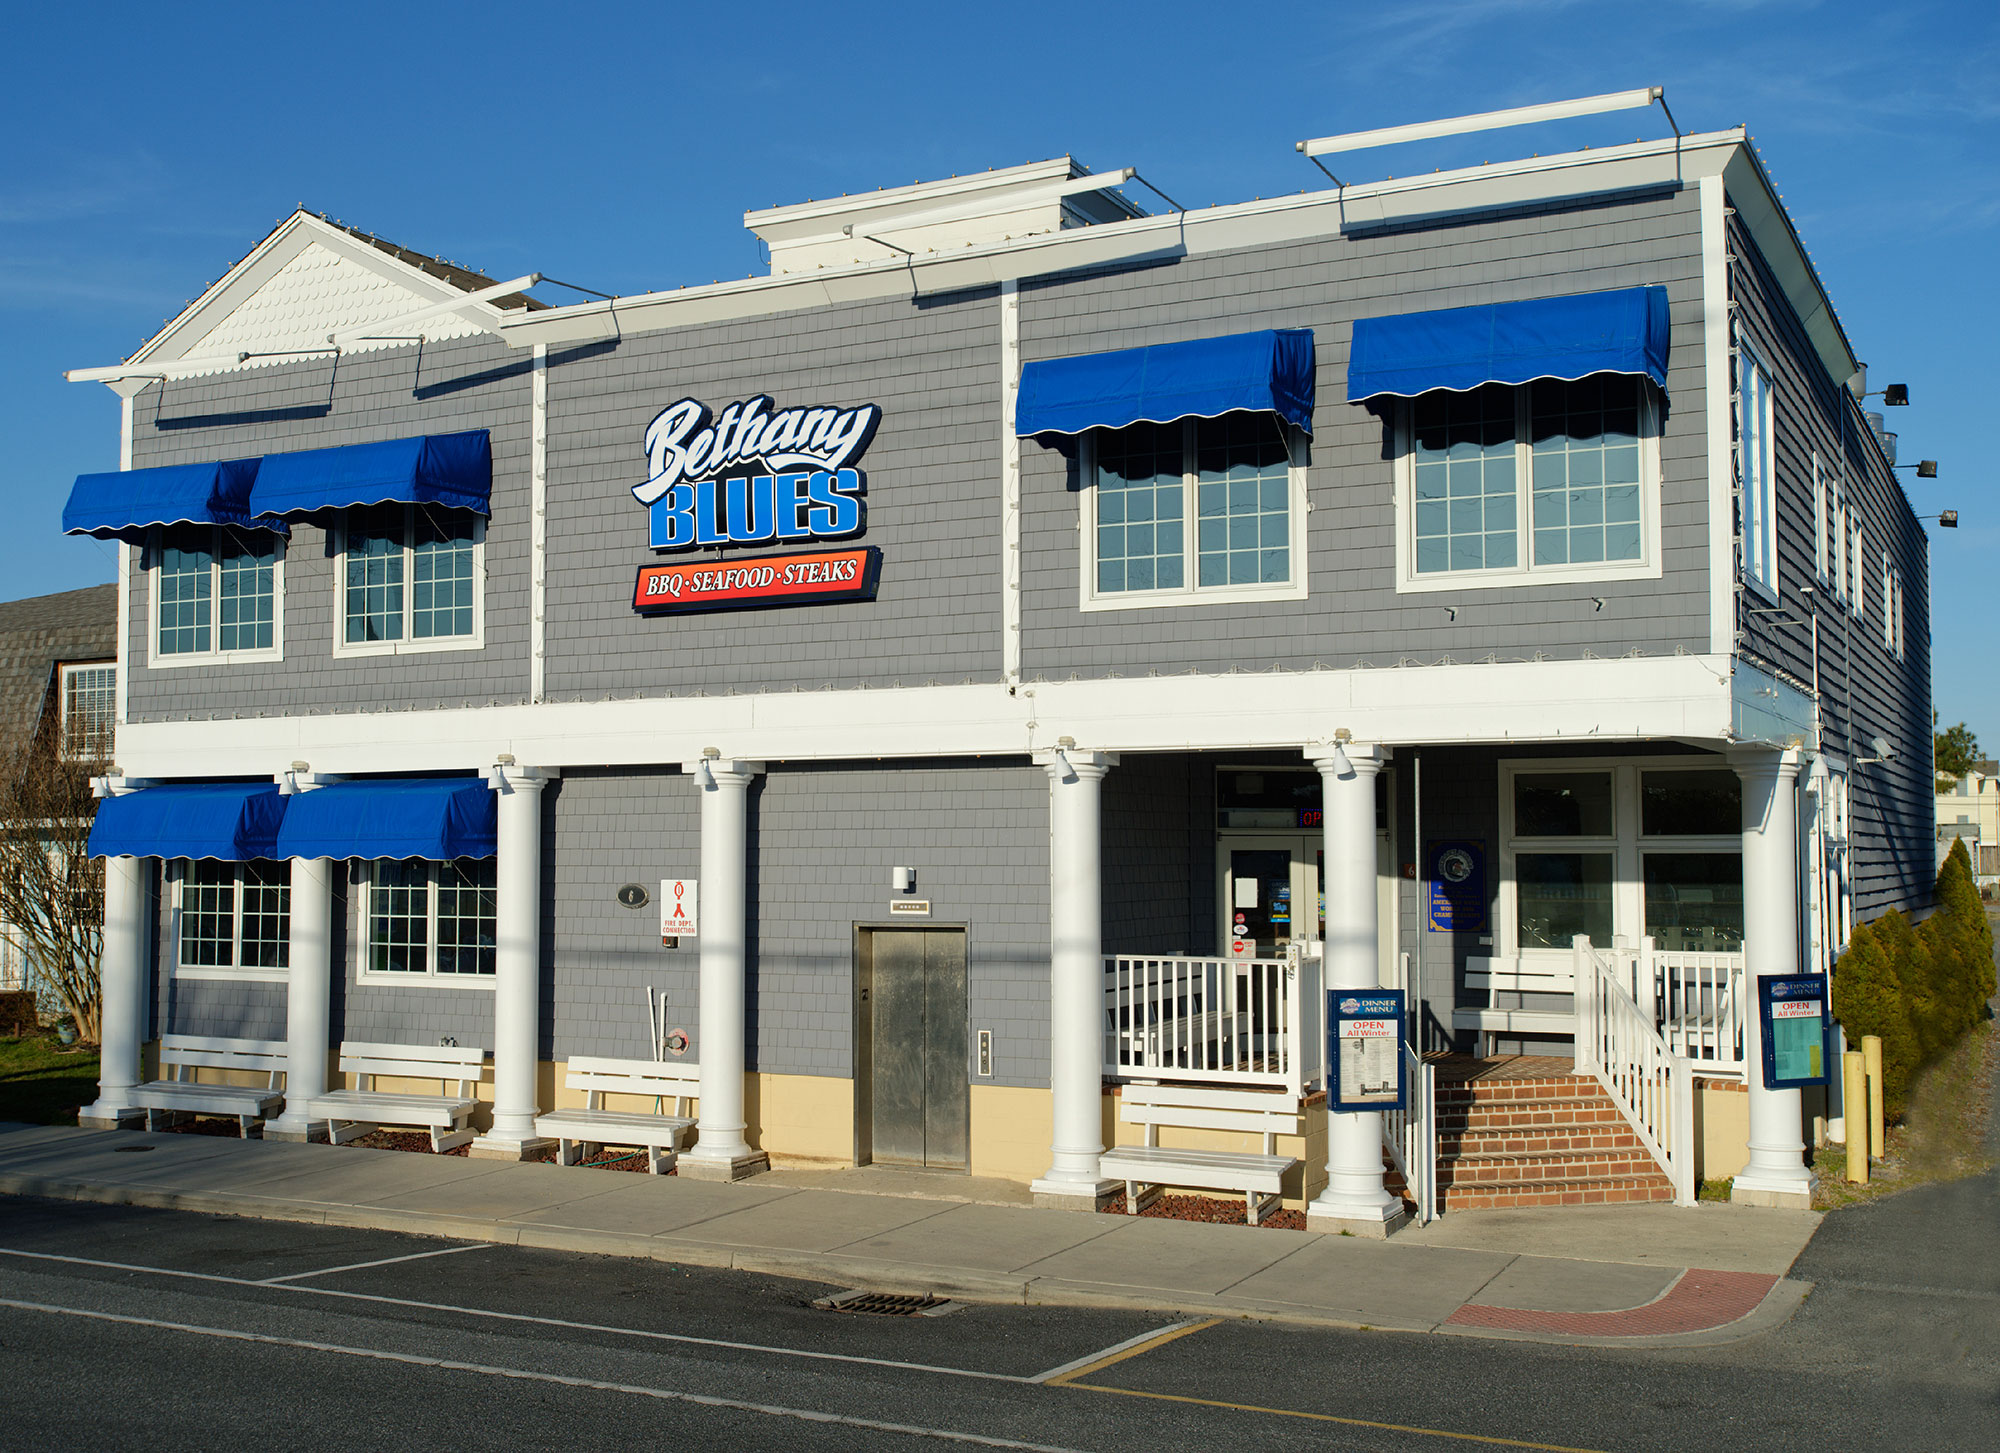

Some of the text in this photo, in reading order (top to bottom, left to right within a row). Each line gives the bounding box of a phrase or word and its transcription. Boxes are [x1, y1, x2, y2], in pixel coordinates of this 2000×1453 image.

[631, 397, 873, 503] Bethany
[649, 467, 860, 548] BLUES
[1352, 1021, 1385, 1029] OPEN
[1782, 1002, 1809, 1010] OPEN
